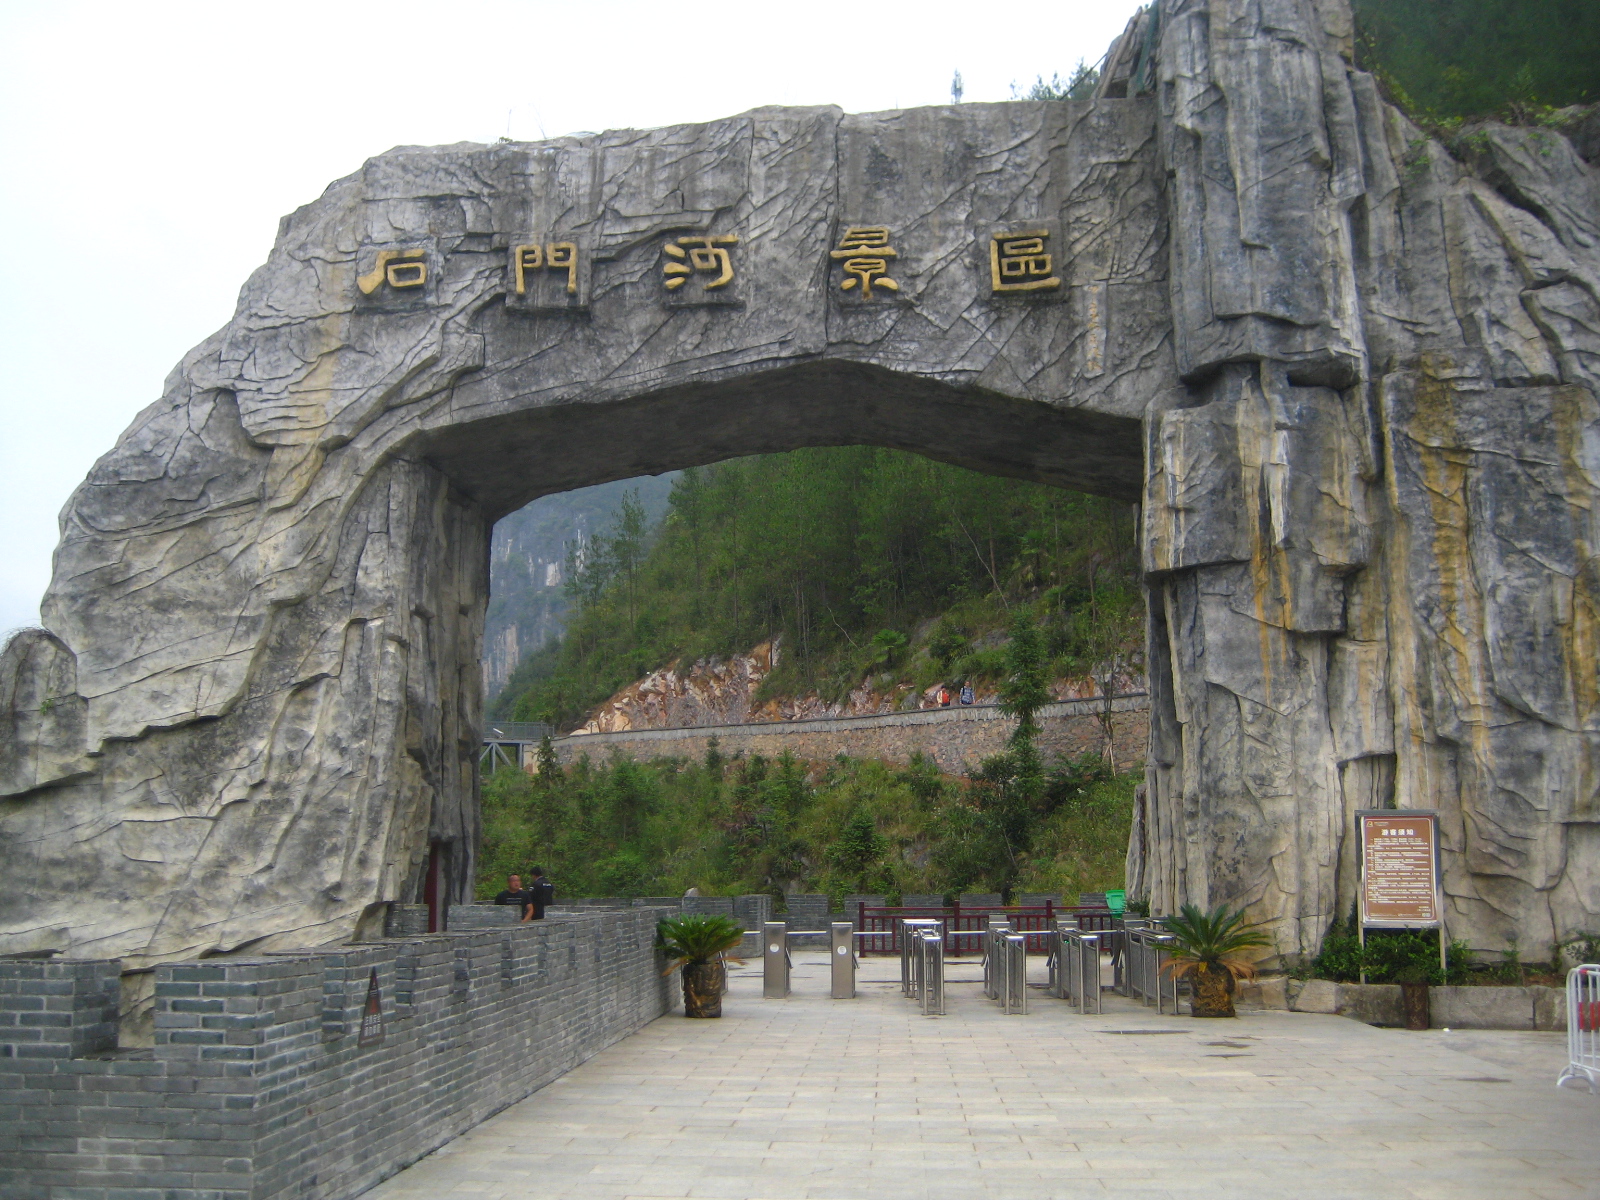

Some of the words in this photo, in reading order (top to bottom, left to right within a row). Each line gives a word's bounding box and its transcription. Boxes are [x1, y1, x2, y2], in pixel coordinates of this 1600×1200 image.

[357, 227, 1060, 300] 石門河景區
